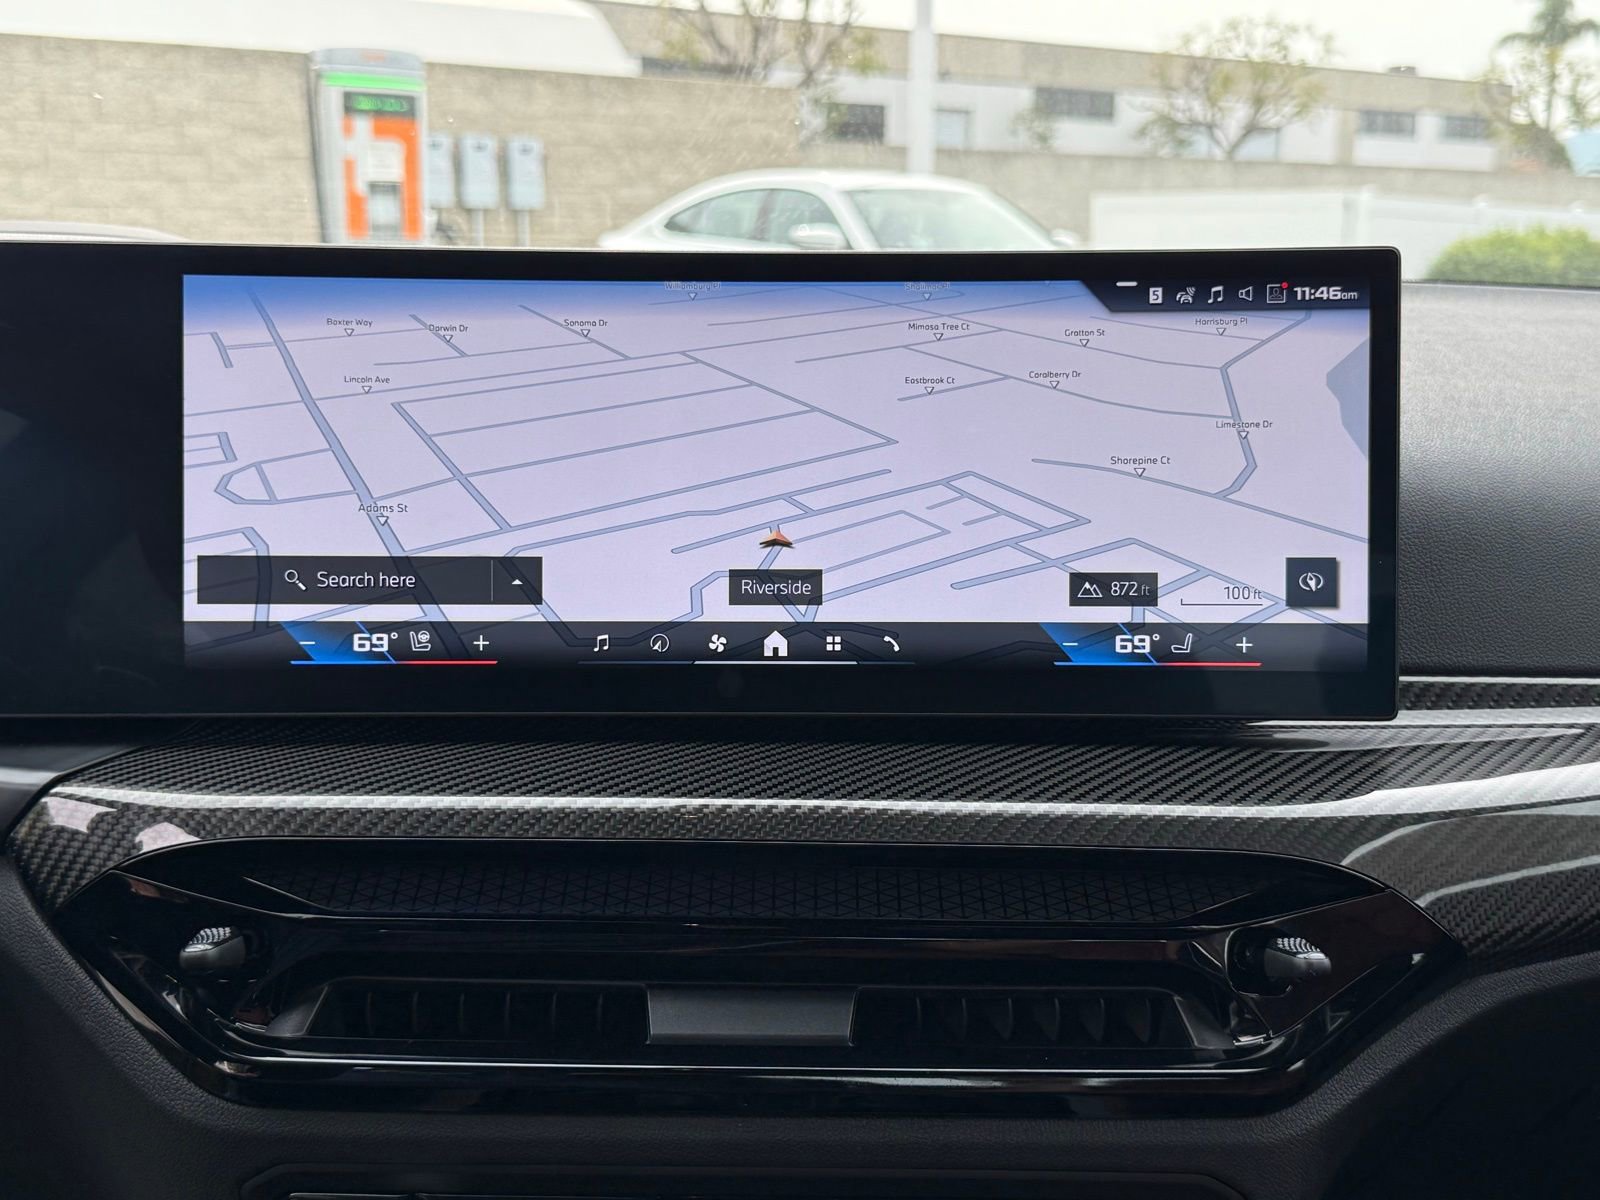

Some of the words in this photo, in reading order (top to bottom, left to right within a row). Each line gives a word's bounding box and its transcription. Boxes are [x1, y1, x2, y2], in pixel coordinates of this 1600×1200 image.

[1294, 286, 1342, 301] 11:46
[326, 317, 353, 326] Baxter
[355, 318, 373, 328] Way
[563, 318, 597, 327] Sonoma
[598, 319, 608, 327] Dr
[1194, 317, 1238, 326] Harrisburg
[1239, 316, 1248, 325] Pl
[428, 323, 457, 332] Darwin
[458, 324, 469, 333] Dr
[907, 322, 939, 331] Mimosa
[940, 322, 959, 331] Tree
[960, 322, 970, 331] Ct
[1064, 328, 1095, 337] Gratton
[1096, 328, 1105, 337] St
[343, 375, 373, 384] Lincoln
[374, 375, 391, 384] Ave
[1028, 370, 1070, 379] Coralberry
[1071, 370, 1082, 378] Dr
[904, 376, 945, 385] Eastbrook
[946, 376, 955, 385] Ct
[1215, 420, 1261, 429] Limestone
[1262, 420, 1273, 429] Dr
[1110, 456, 1158, 467] Shorepine
[1160, 456, 1171, 465] Ct
[358, 503, 395, 513] Adams
[397, 503, 408, 513] St
[316, 571, 374, 588] Search
[379, 571, 416, 588] here
[741, 579, 812, 595] Riverside
[1110, 581, 1139, 596] 872
[1141, 584, 1151, 596] ft
[1223, 586, 1251, 600] 100
[1253, 589, 1263, 600] ft
